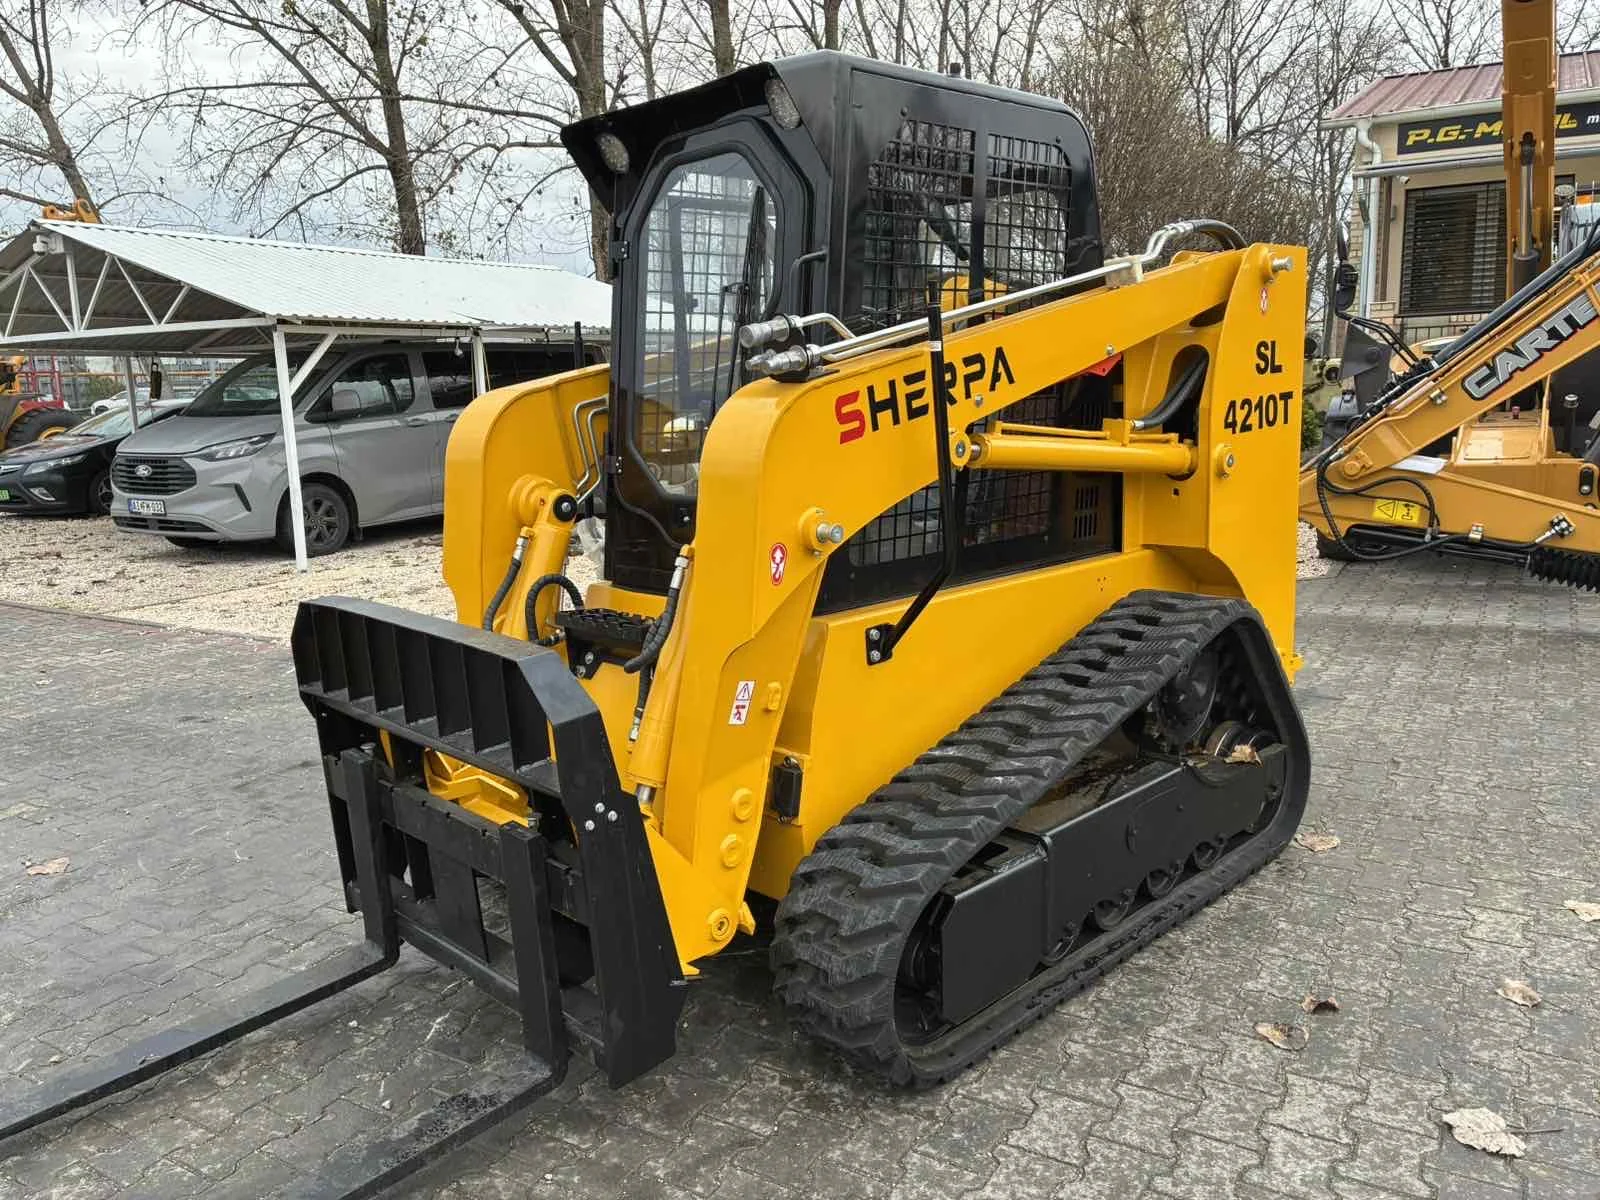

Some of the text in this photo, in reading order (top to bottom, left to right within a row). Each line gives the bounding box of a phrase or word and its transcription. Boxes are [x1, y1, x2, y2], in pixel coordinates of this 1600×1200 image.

[1255, 340, 1283, 375] SL
[1463, 287, 1600, 399] CARTE
[834, 345, 1016, 445] SHERPA
[1223, 390, 1294, 435] 4210T
